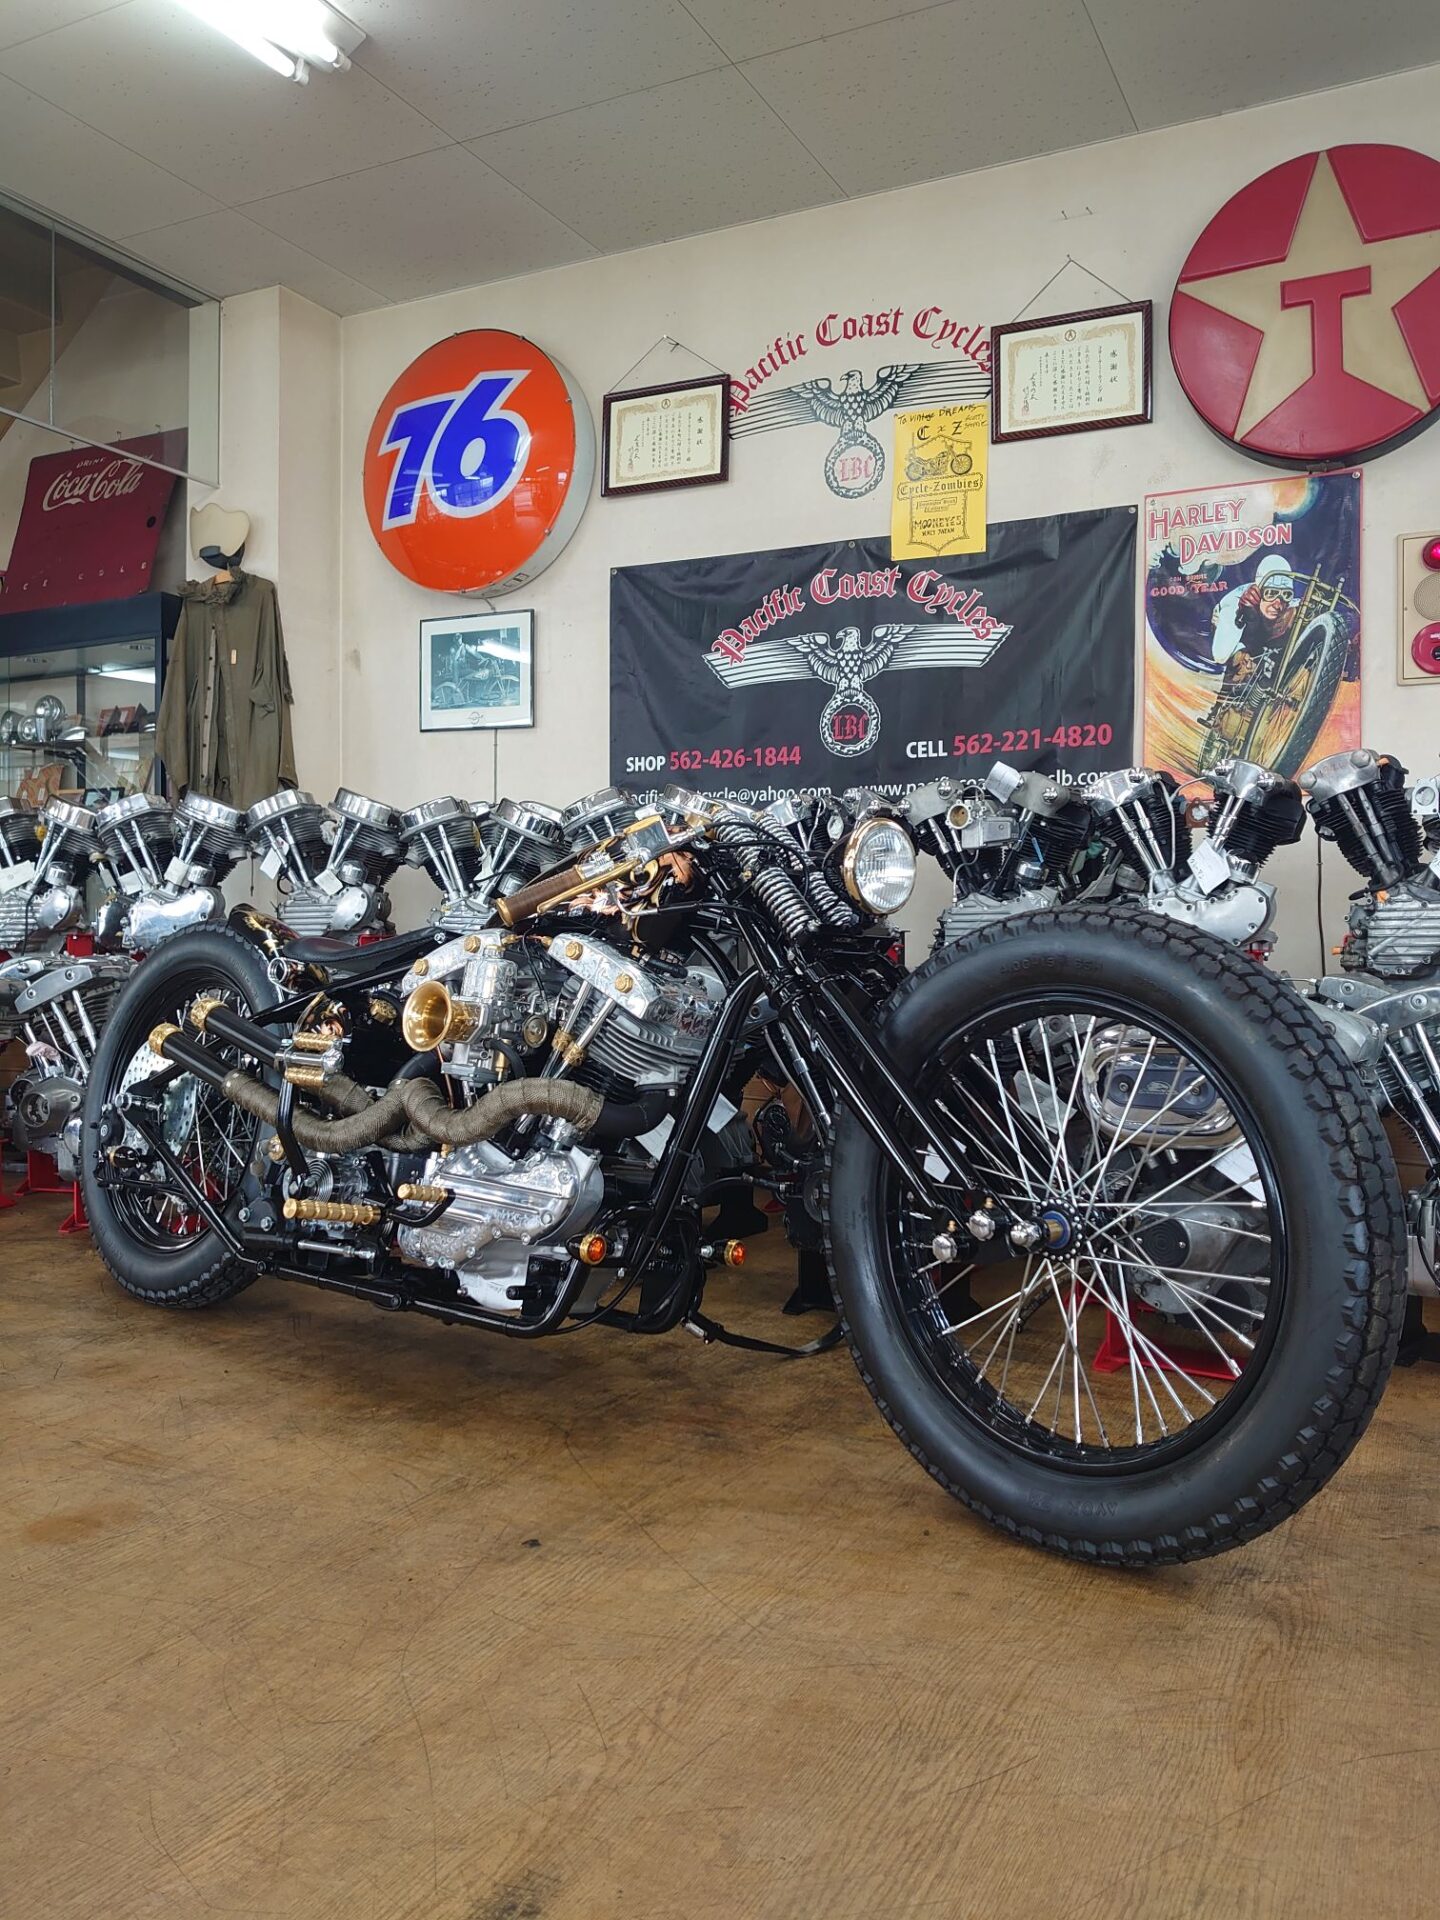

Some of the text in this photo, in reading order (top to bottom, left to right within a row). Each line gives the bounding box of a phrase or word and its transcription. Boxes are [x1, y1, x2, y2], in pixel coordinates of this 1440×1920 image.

[729, 332, 809, 416] Pacific
[815, 305, 905, 347] Coast
[951, 421, 962, 436] Z
[377, 369, 532, 532] 76
[900, 478, 980, 496] Cycle-Zombies
[1149, 497, 1247, 541] HARLEY
[1179, 522, 1293, 566] DAVIDSON
[1150, 580, 1229, 598] GOOD YEAR
[711, 564, 1005, 667] Pacific Coast Cycles
[626, 745, 802, 773] SHOP 562-426-1844
[906, 723, 1113, 759] CELL 562-221-4820
